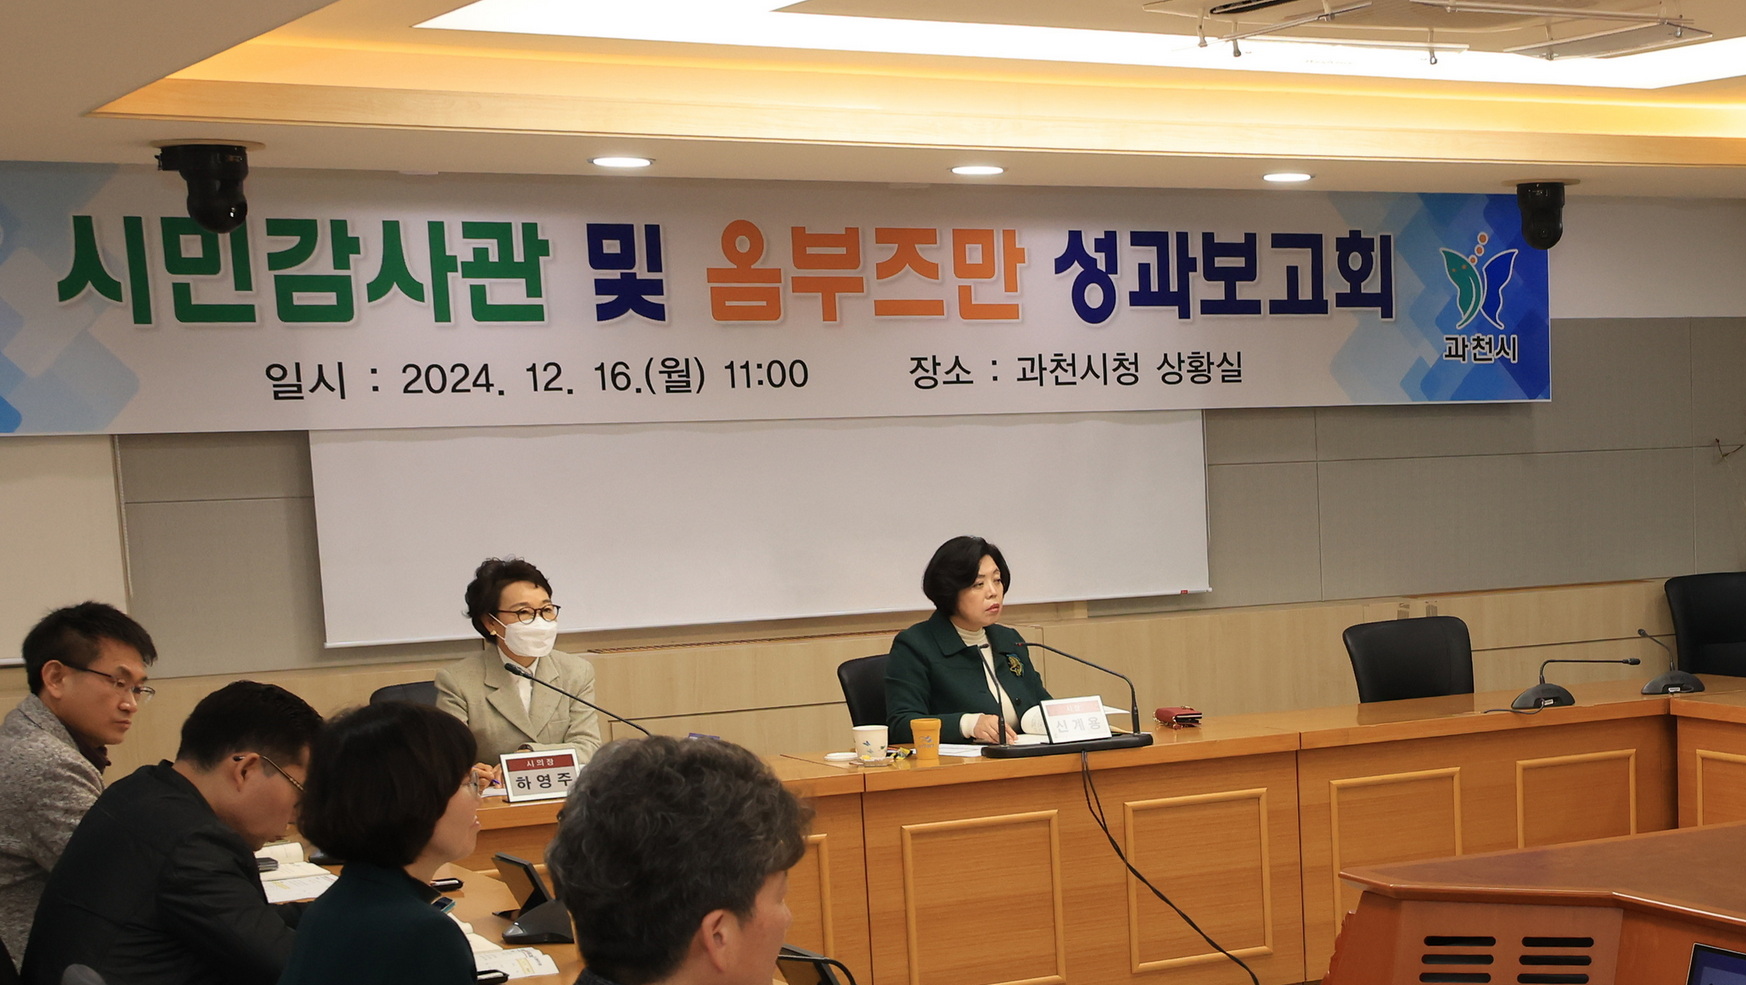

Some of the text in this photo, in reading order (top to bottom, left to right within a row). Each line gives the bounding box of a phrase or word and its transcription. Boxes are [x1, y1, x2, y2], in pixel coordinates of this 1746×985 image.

[57, 214, 1394, 325] 시민감사관 및 옴부즈만 성과보고회
[1443, 335, 1518, 363] 과천시
[264, 361, 347, 401] 일시
[401, 363, 506, 396] 2024.
[526, 361, 575, 395] 12.
[594, 356, 706, 395] 16.(월)
[724, 359, 809, 389] 11:00
[909, 354, 974, 390] 장소
[1016, 351, 1140, 387] 과천시청
[1156, 350, 1244, 385] 상황실
